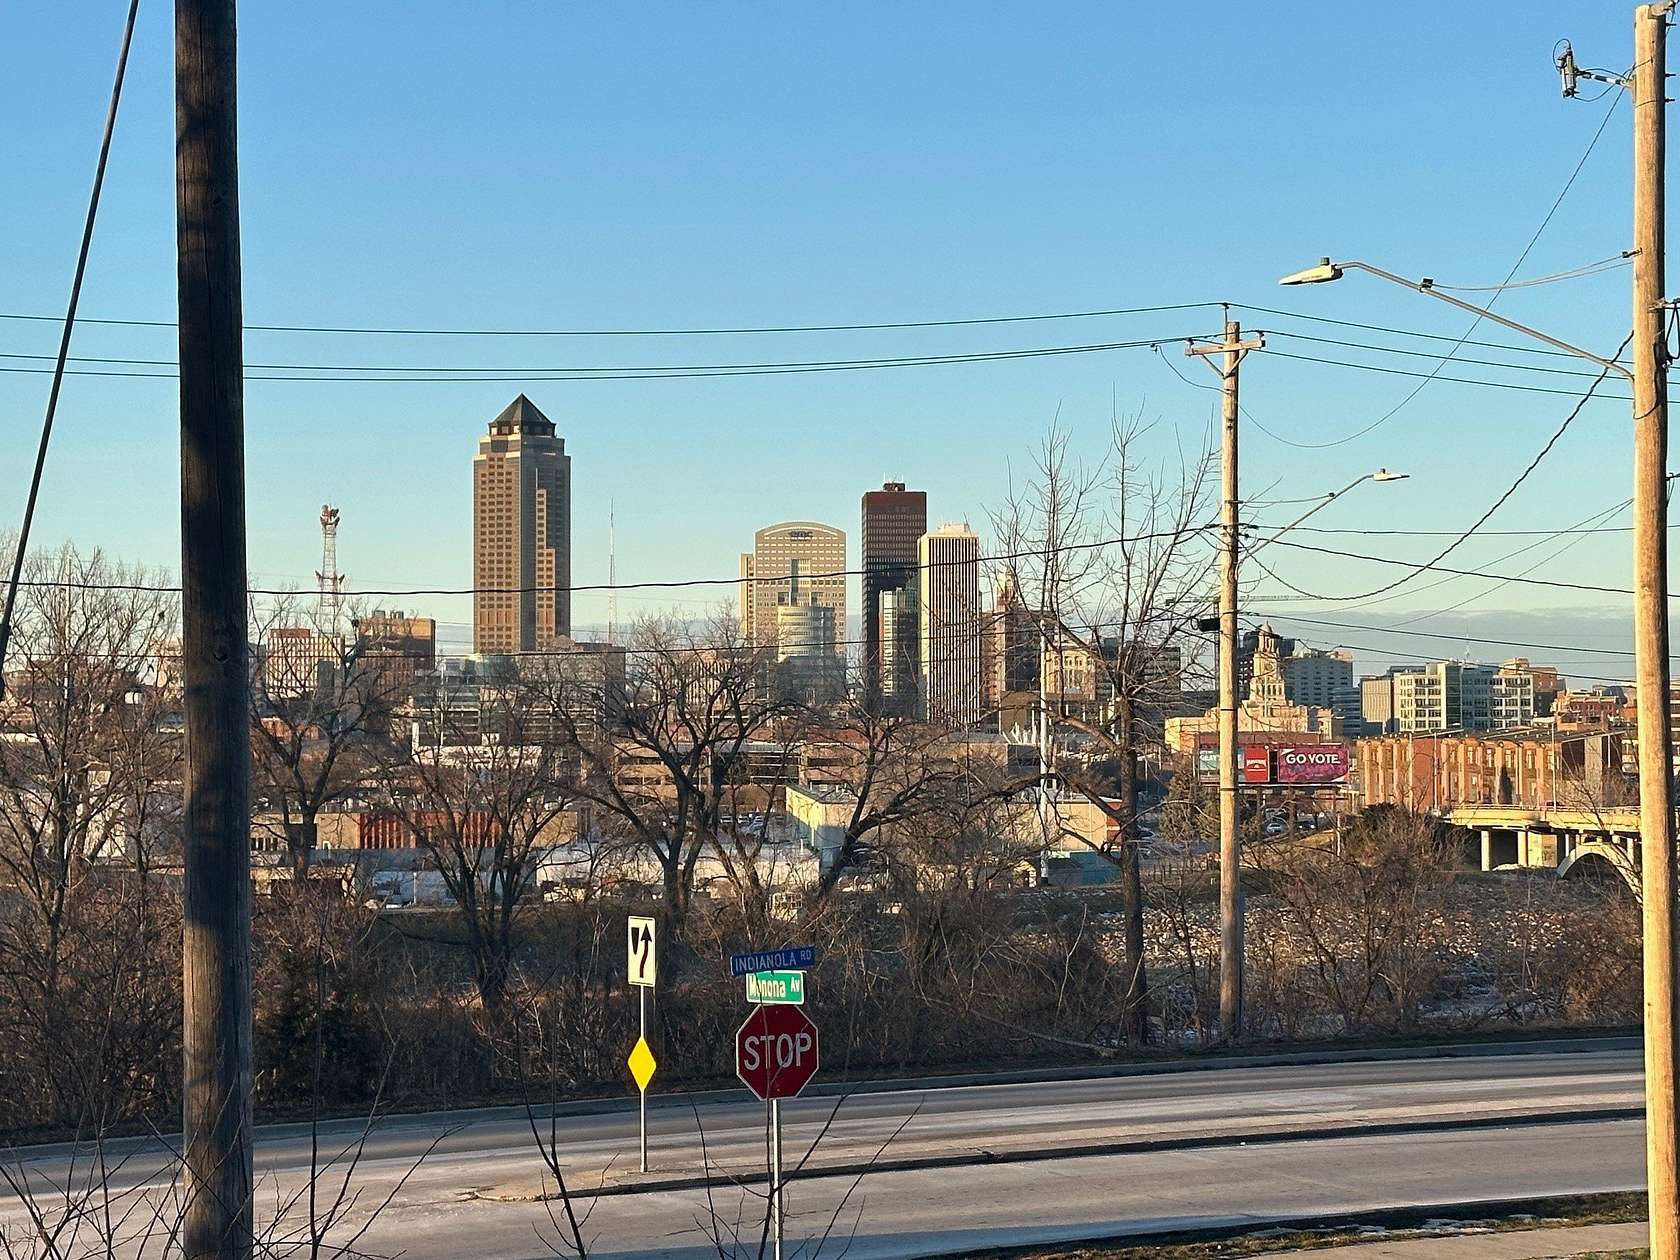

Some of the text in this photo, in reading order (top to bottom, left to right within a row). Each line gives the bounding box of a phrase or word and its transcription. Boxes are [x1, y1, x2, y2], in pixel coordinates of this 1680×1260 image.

[1286, 753, 1306, 764] GO
[735, 950, 811, 971] INDIANOLA RD
[749, 975, 786, 998] Monona
[744, 1033, 812, 1071] STOP
